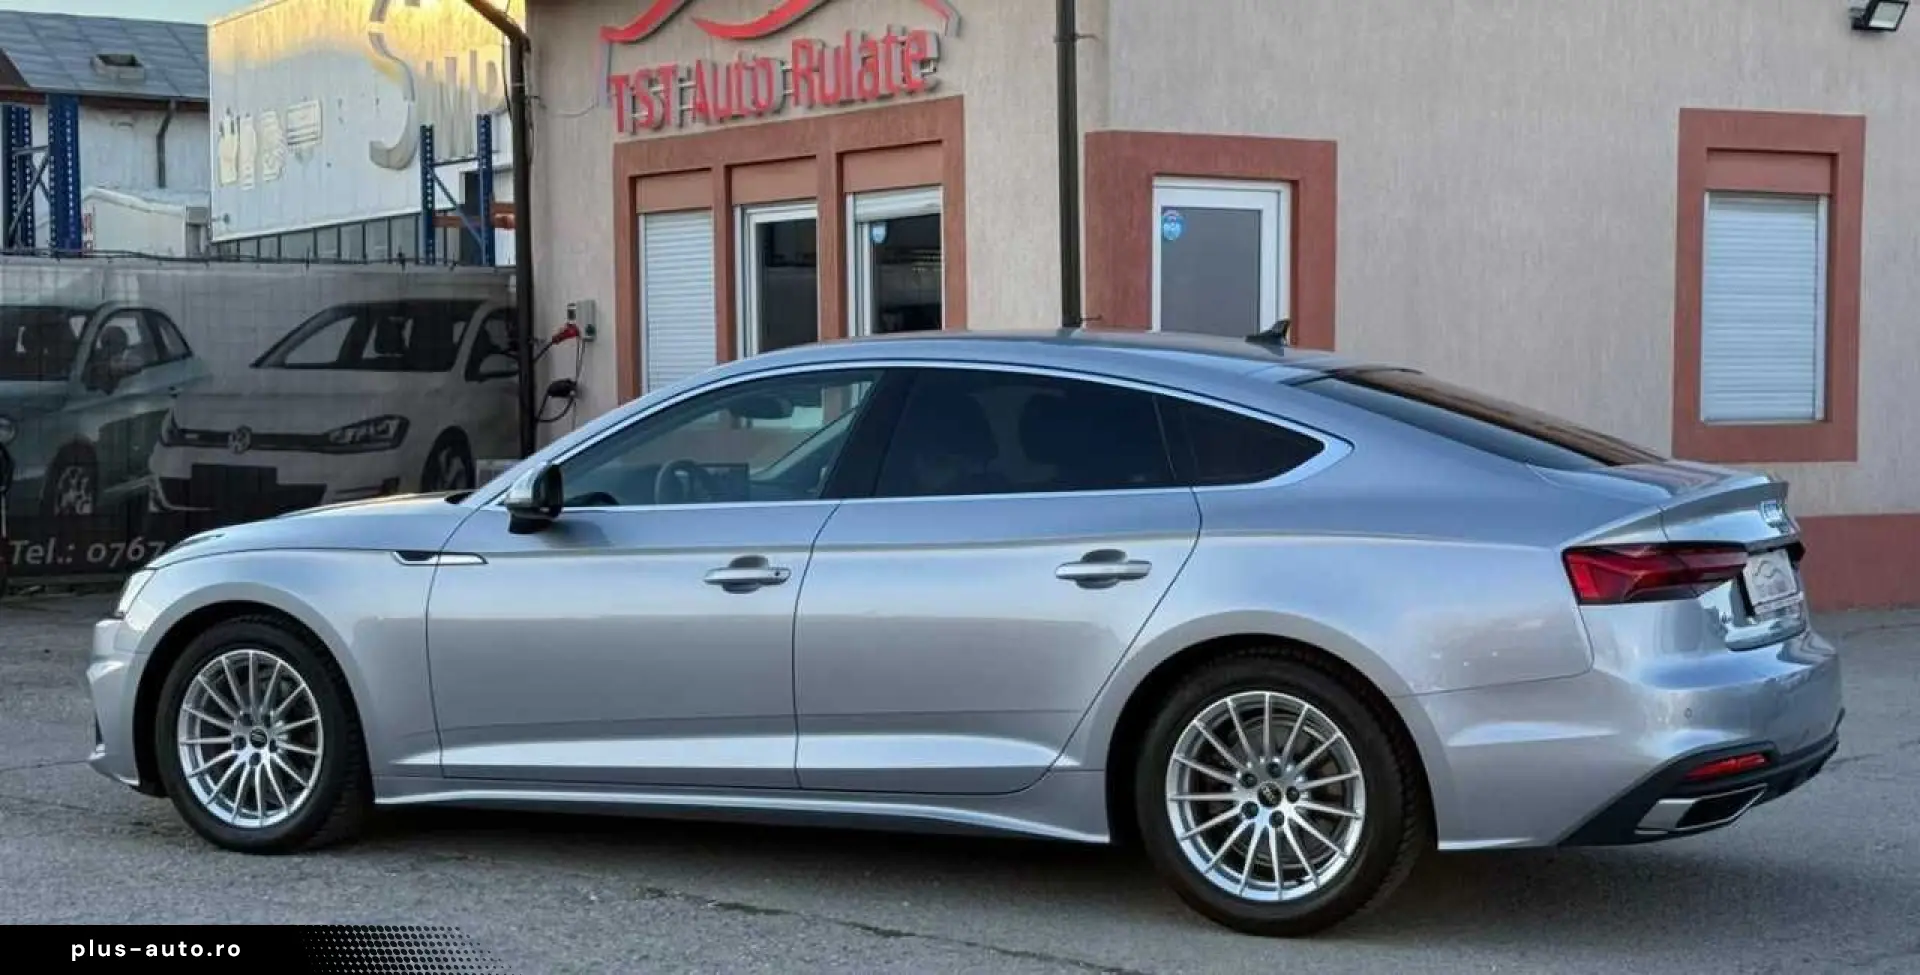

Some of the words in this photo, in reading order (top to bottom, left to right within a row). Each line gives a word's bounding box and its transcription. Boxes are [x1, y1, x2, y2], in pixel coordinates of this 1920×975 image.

[609, 63, 684, 134] TST
[693, 53, 779, 126] Auto
[791, 26, 936, 107] Rulate
[9, 537, 75, 565] Tel.:
